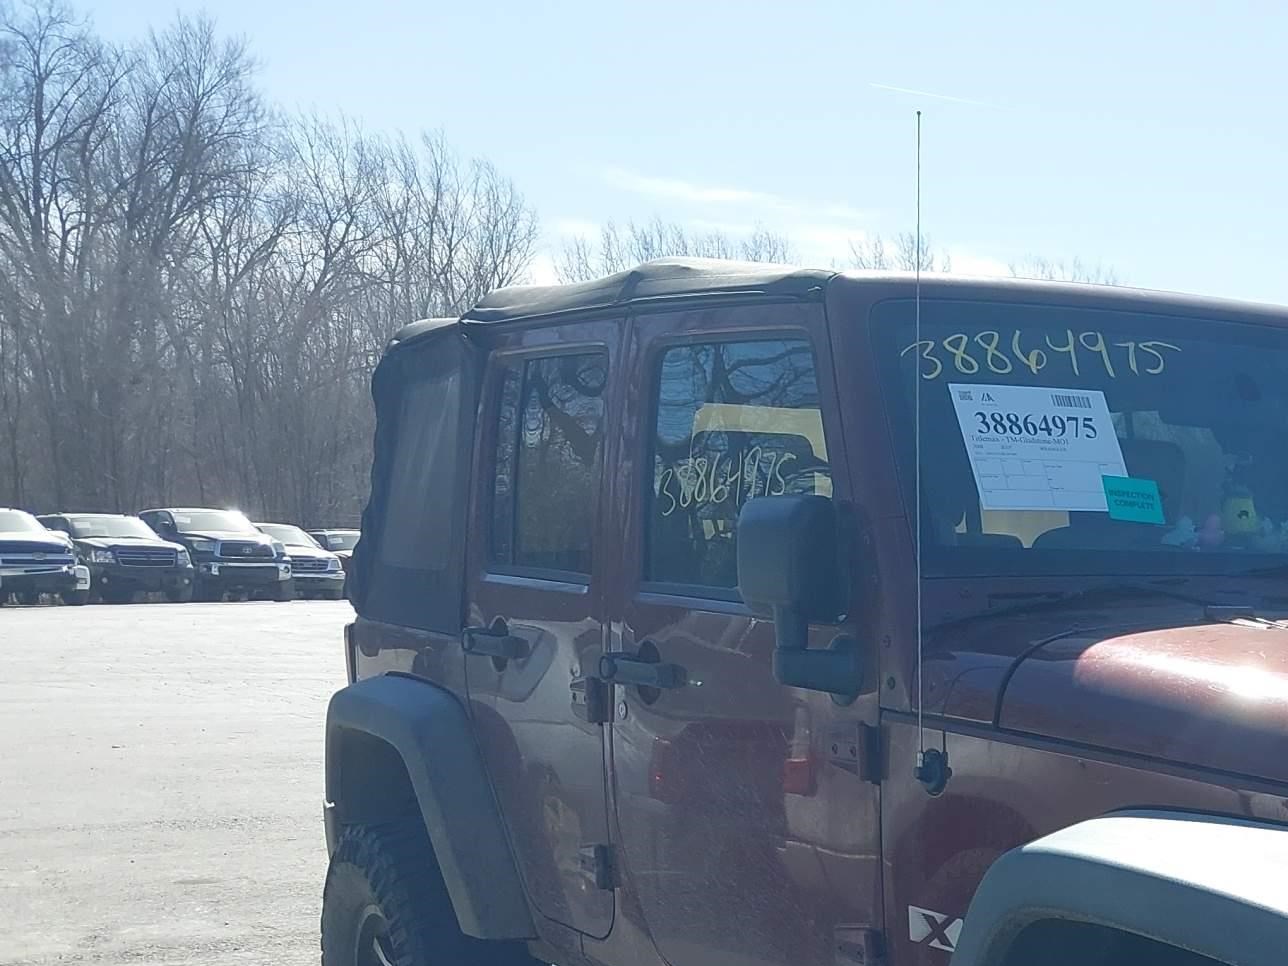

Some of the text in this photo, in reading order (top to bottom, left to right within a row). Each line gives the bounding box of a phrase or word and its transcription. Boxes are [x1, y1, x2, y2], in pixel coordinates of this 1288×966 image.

[900, 329, 1181, 379] 38864975
[974, 411, 1097, 439] 38864975
[660, 446, 797, 516] 38864975
